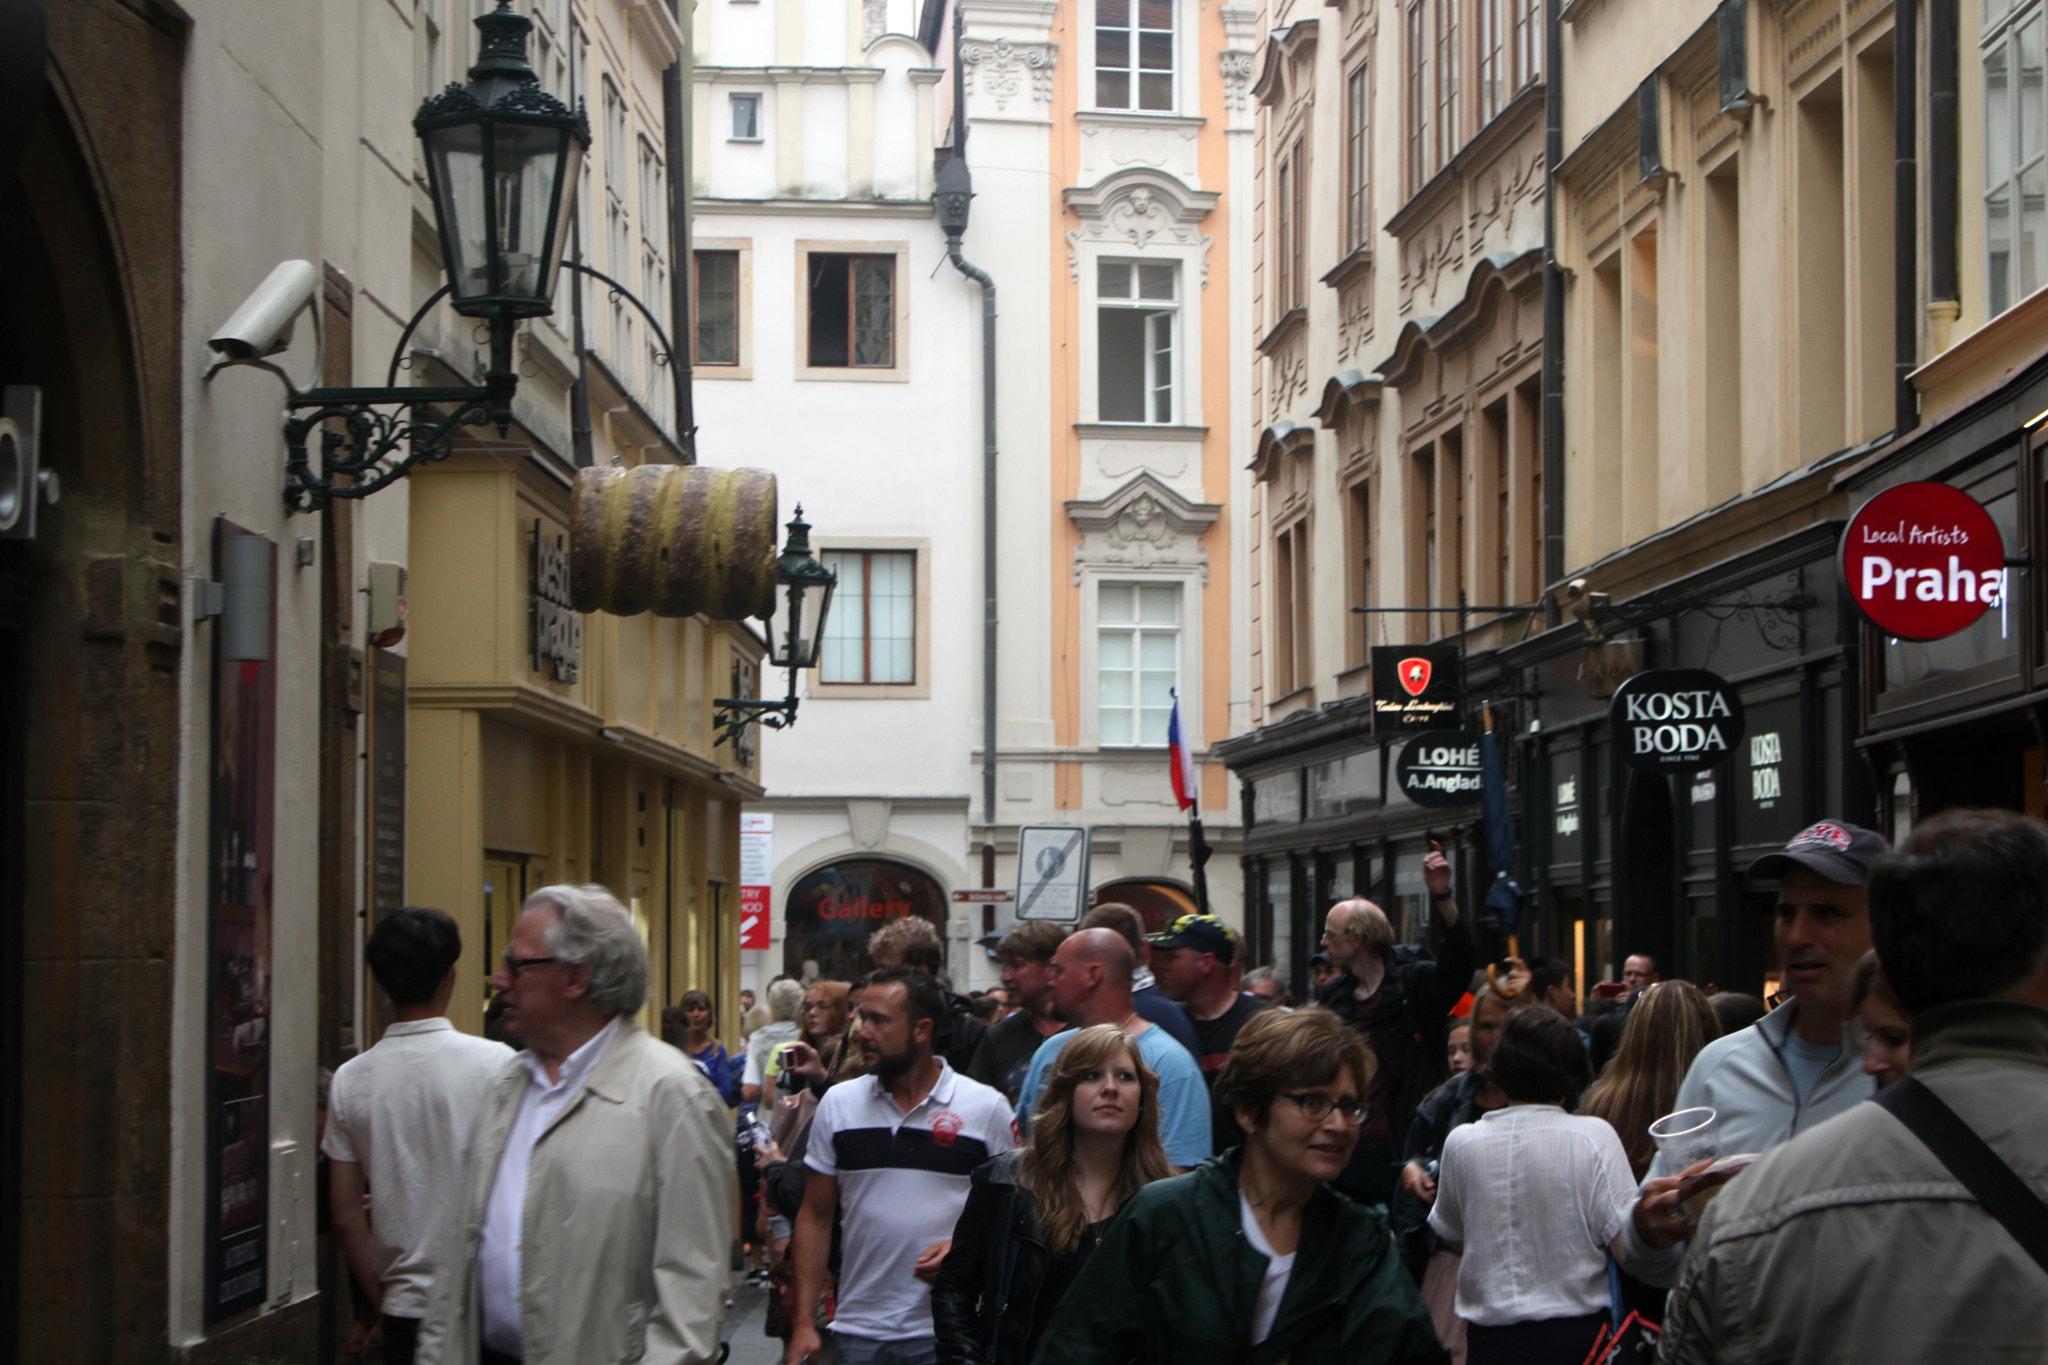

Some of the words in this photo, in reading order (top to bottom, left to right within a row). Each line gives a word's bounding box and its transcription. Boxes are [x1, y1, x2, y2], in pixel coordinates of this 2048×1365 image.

[1862, 520, 1905, 544] Local
[1909, 524, 1970, 546] Artists
[1861, 555, 2005, 603] Praha
[1625, 690, 1732, 721] KOSTA
[1633, 724, 1728, 754] BODA
[1418, 743, 1480, 766] LOHÉ
[1406, 773, 1484, 793] A.Anglad
[817, 896, 911, 919] Gallery
